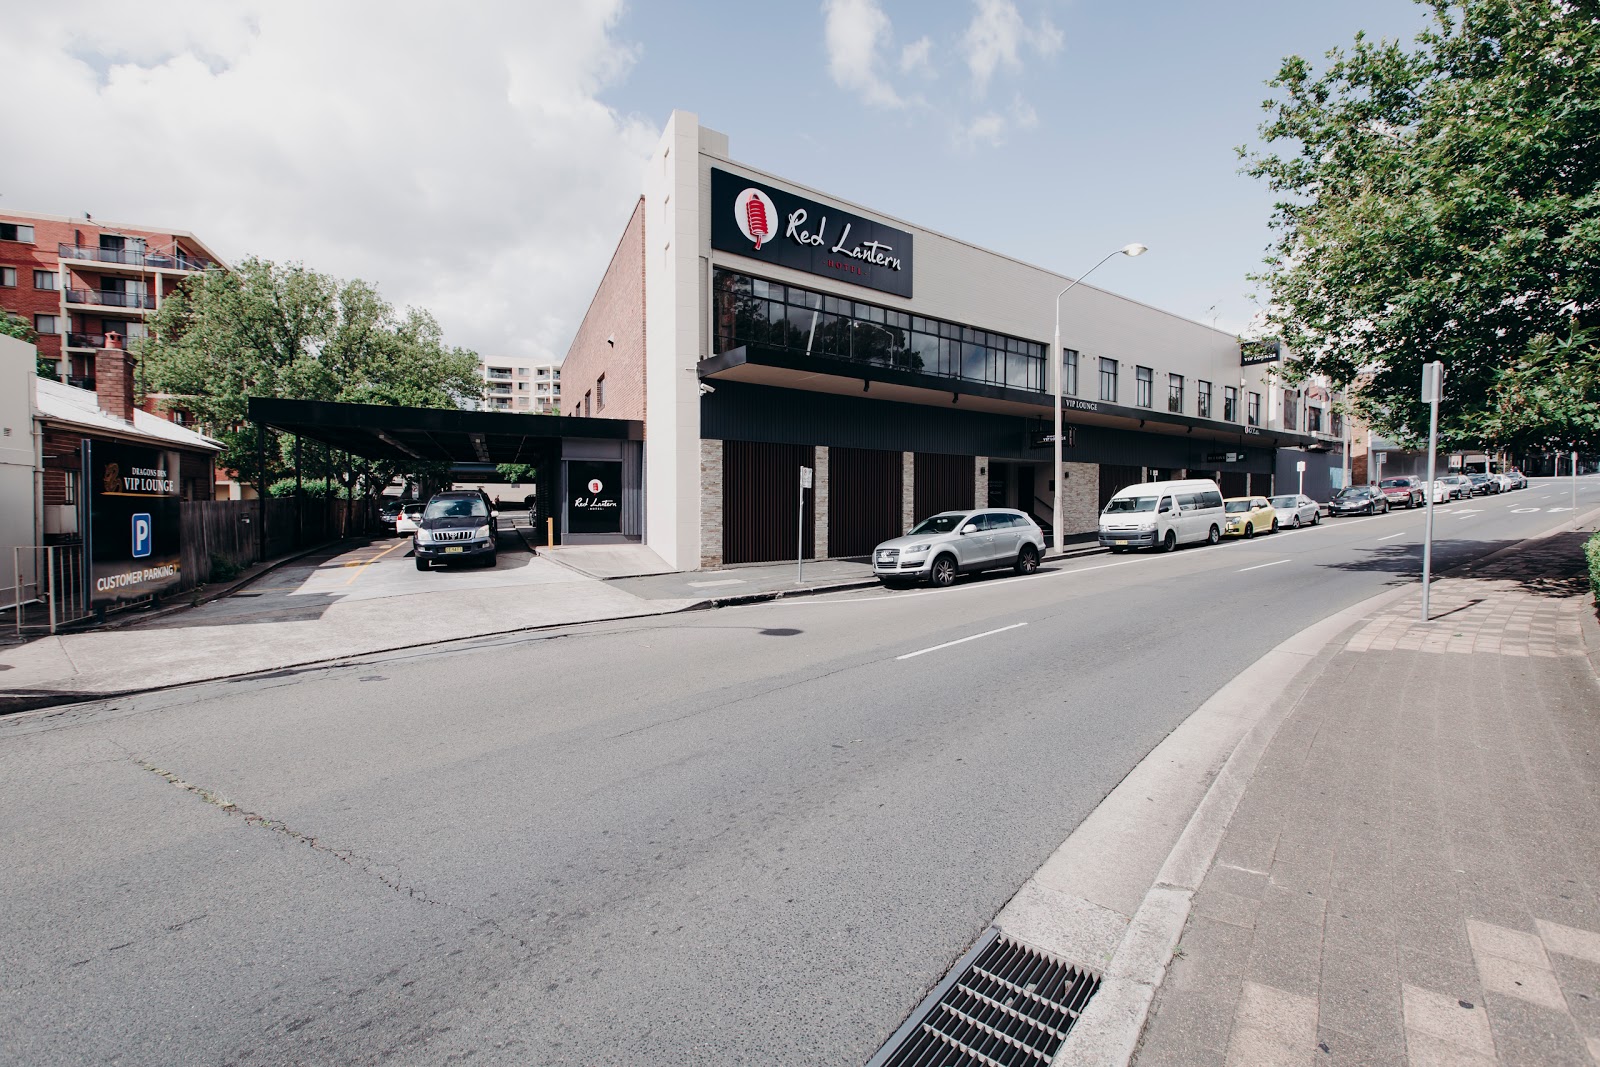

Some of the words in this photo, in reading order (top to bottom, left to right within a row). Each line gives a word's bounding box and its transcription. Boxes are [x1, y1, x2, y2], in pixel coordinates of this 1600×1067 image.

[785, 208, 827, 246] Red
[831, 223, 902, 270] Lantern
[1066, 399, 1076, 408] VIP
[1076, 401, 1098, 411] LOUNGE
[131, 466, 157, 477] DRAGONS
[157, 469, 167, 478] DEN
[123, 477, 140, 491] VIP
[141, 478, 174, 492] LOUNGE
[574, 497, 589, 507] Red
[590, 497, 617, 507] Lantern
[136, 519, 149, 551] P
[96, 570, 143, 592] CUSTOMER
[143, 564, 174, 582] PARKING
